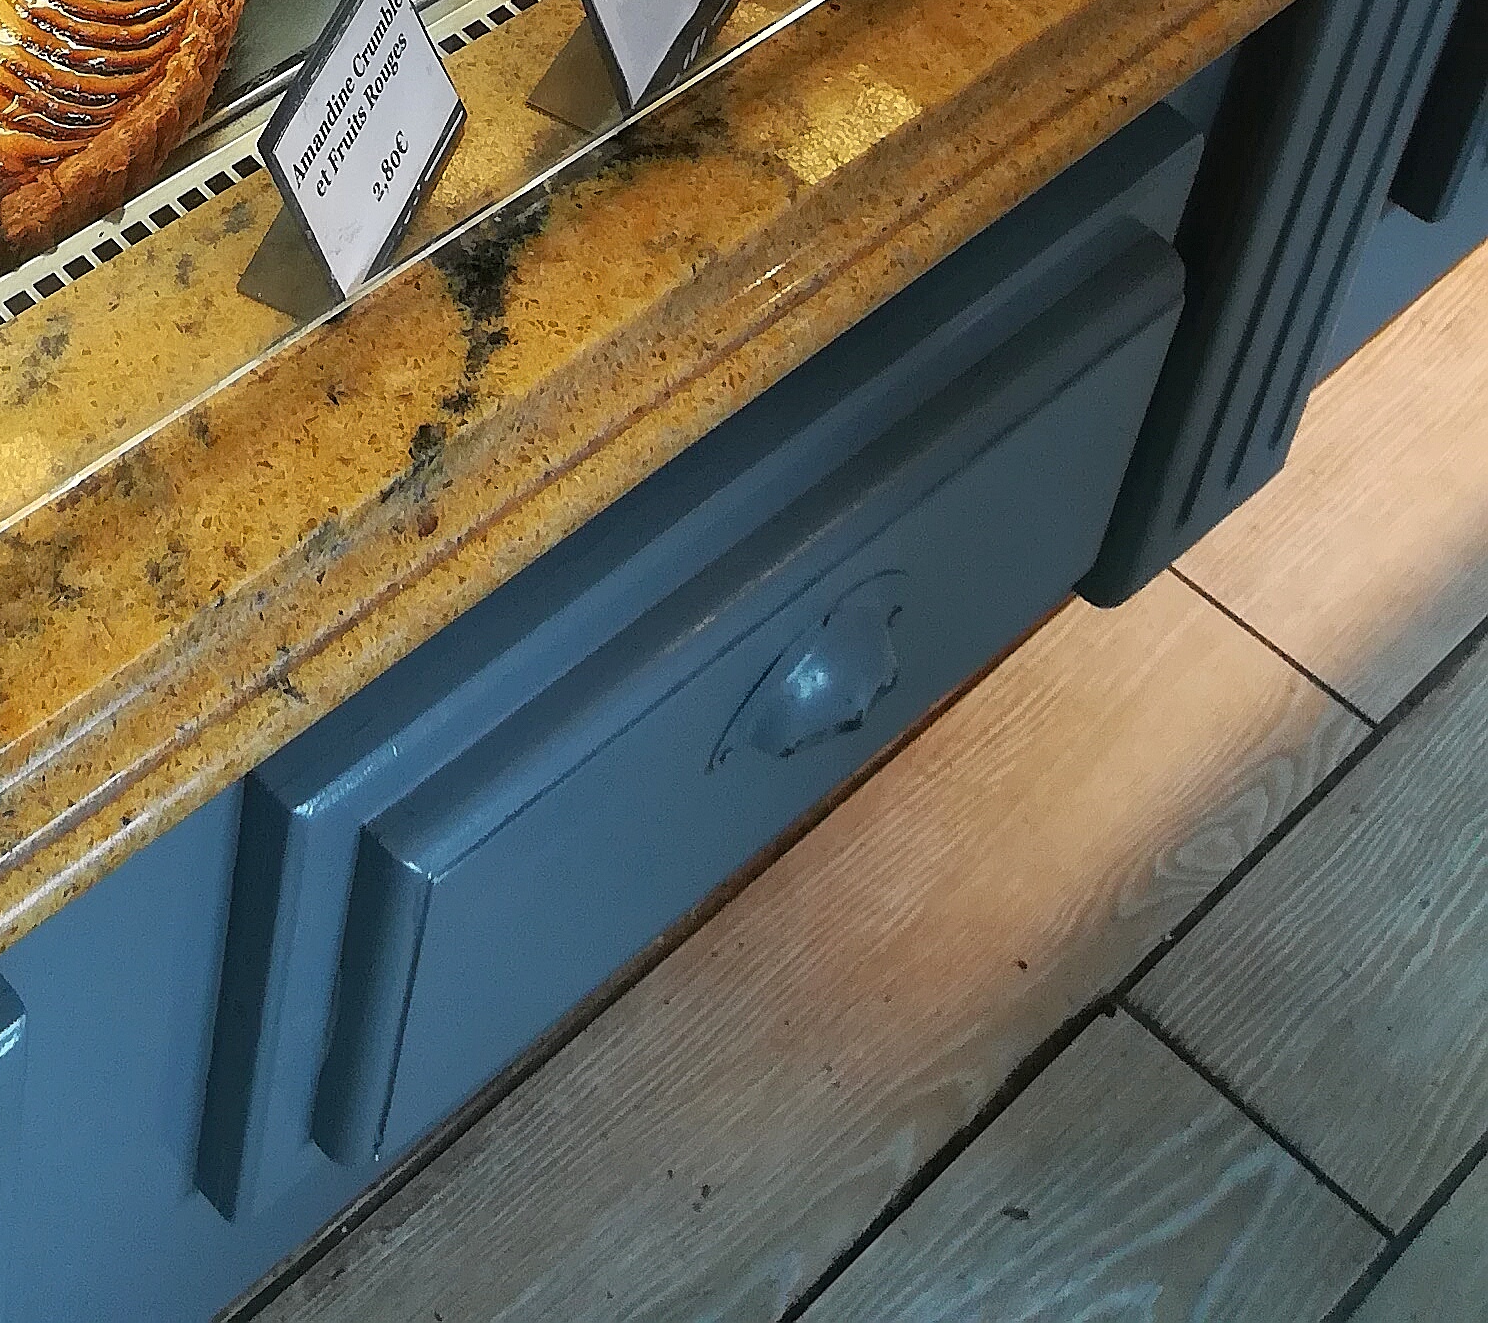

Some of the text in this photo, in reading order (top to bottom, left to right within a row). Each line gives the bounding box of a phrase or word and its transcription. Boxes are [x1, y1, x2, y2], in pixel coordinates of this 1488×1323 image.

[293, 78, 356, 189] Amandine
[315, 32, 408, 198] et Fruits Rouges
[372, 130, 410, 202] 2,80€
